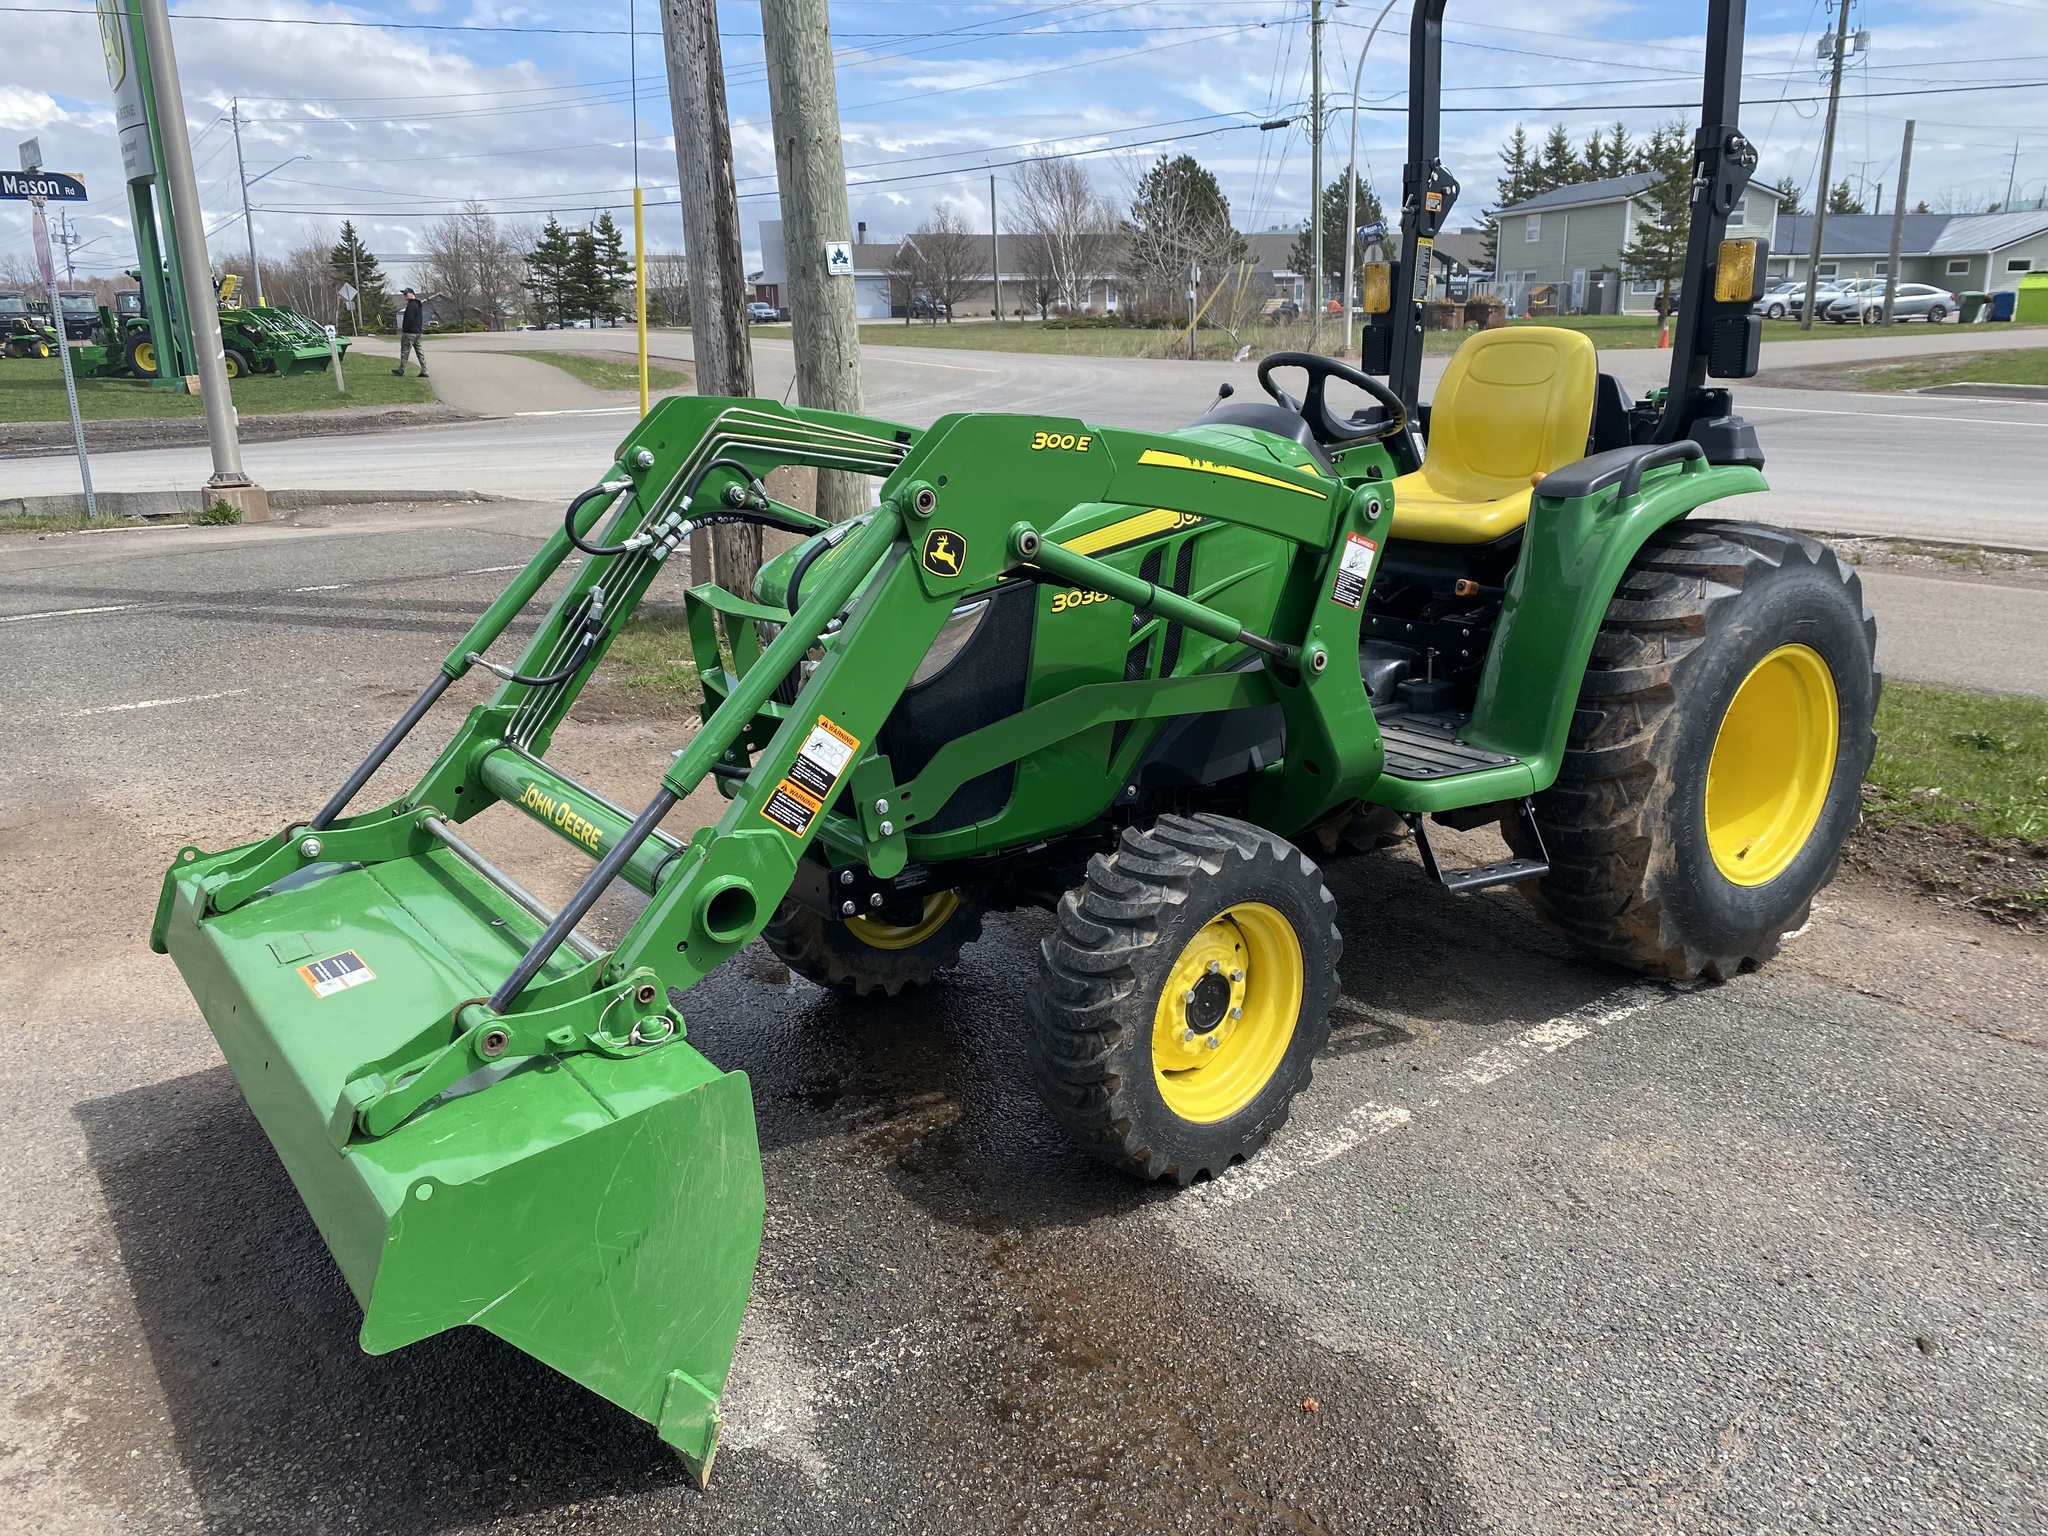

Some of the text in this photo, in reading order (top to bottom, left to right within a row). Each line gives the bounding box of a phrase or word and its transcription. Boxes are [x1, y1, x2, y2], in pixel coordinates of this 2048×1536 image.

[2, 175, 76, 196] Mason Rd
[1356, 537, 1375, 549] DANGER
[828, 723, 856, 747] WARNING
[789, 788, 817, 810] WARNING
[519, 782, 604, 852] JOHN DEERE
